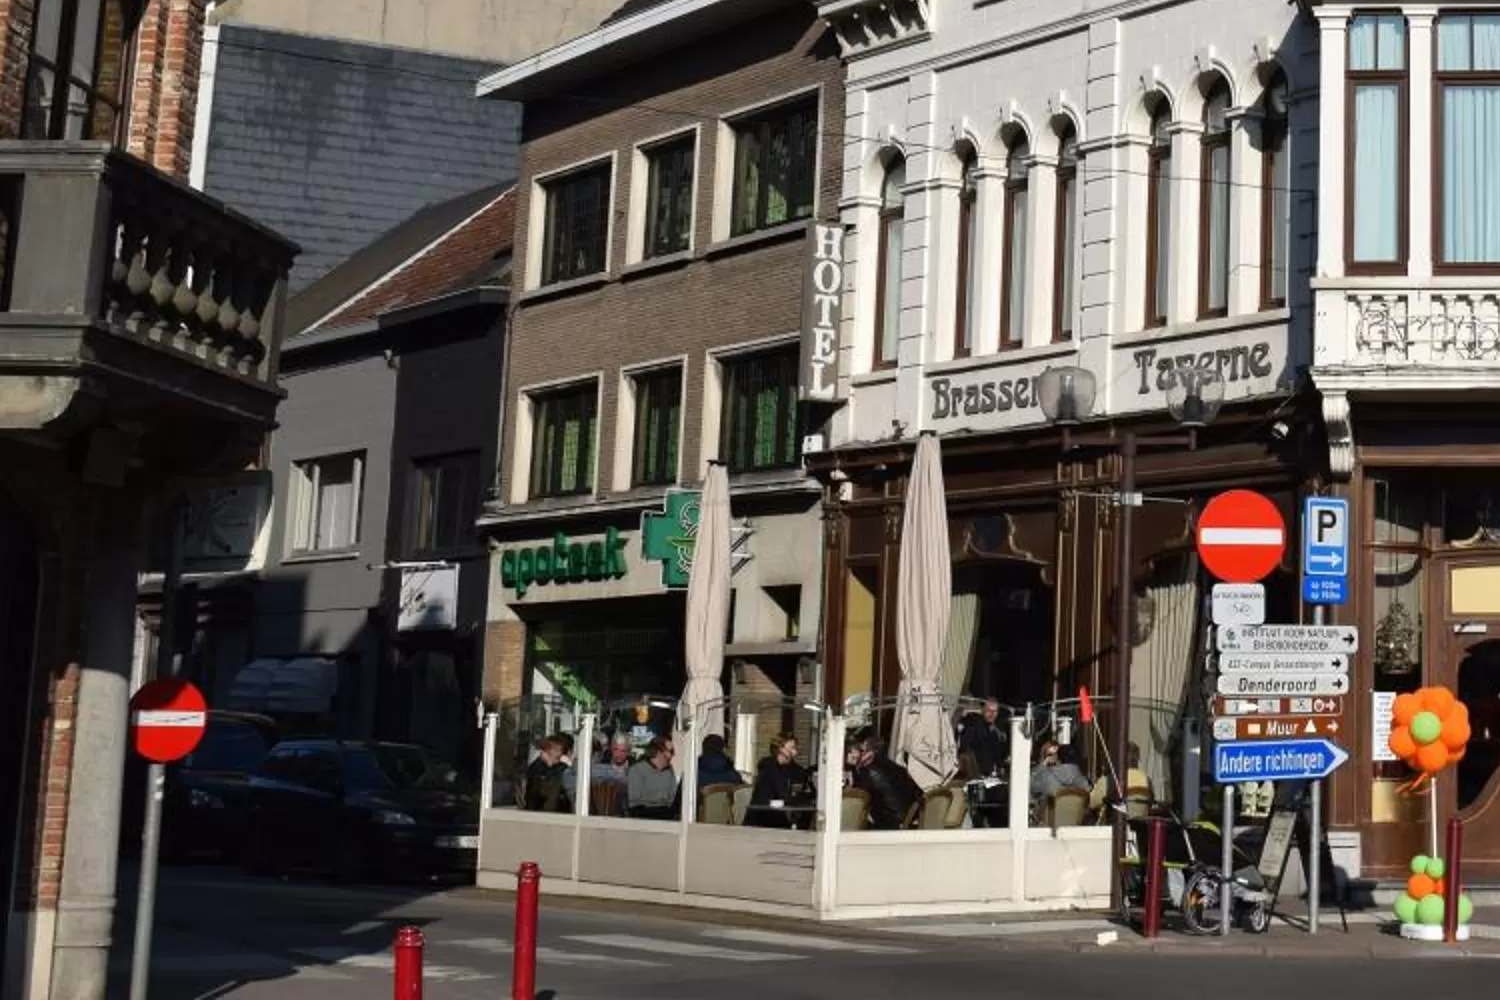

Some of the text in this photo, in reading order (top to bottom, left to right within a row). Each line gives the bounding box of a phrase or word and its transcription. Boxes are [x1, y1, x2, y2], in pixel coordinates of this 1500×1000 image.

[810, 225, 843, 399] HOTEL
[1133, 342, 1273, 395] Taverne
[931, 366, 1053, 420] Brasser
[1317, 509, 1337, 543] P
[501, 526, 628, 599] apoteek
[1237, 677, 1318, 693] Denderoord
[1265, 720, 1299, 735] Muur
[1220, 748, 1325, 775] Andere richtingen
